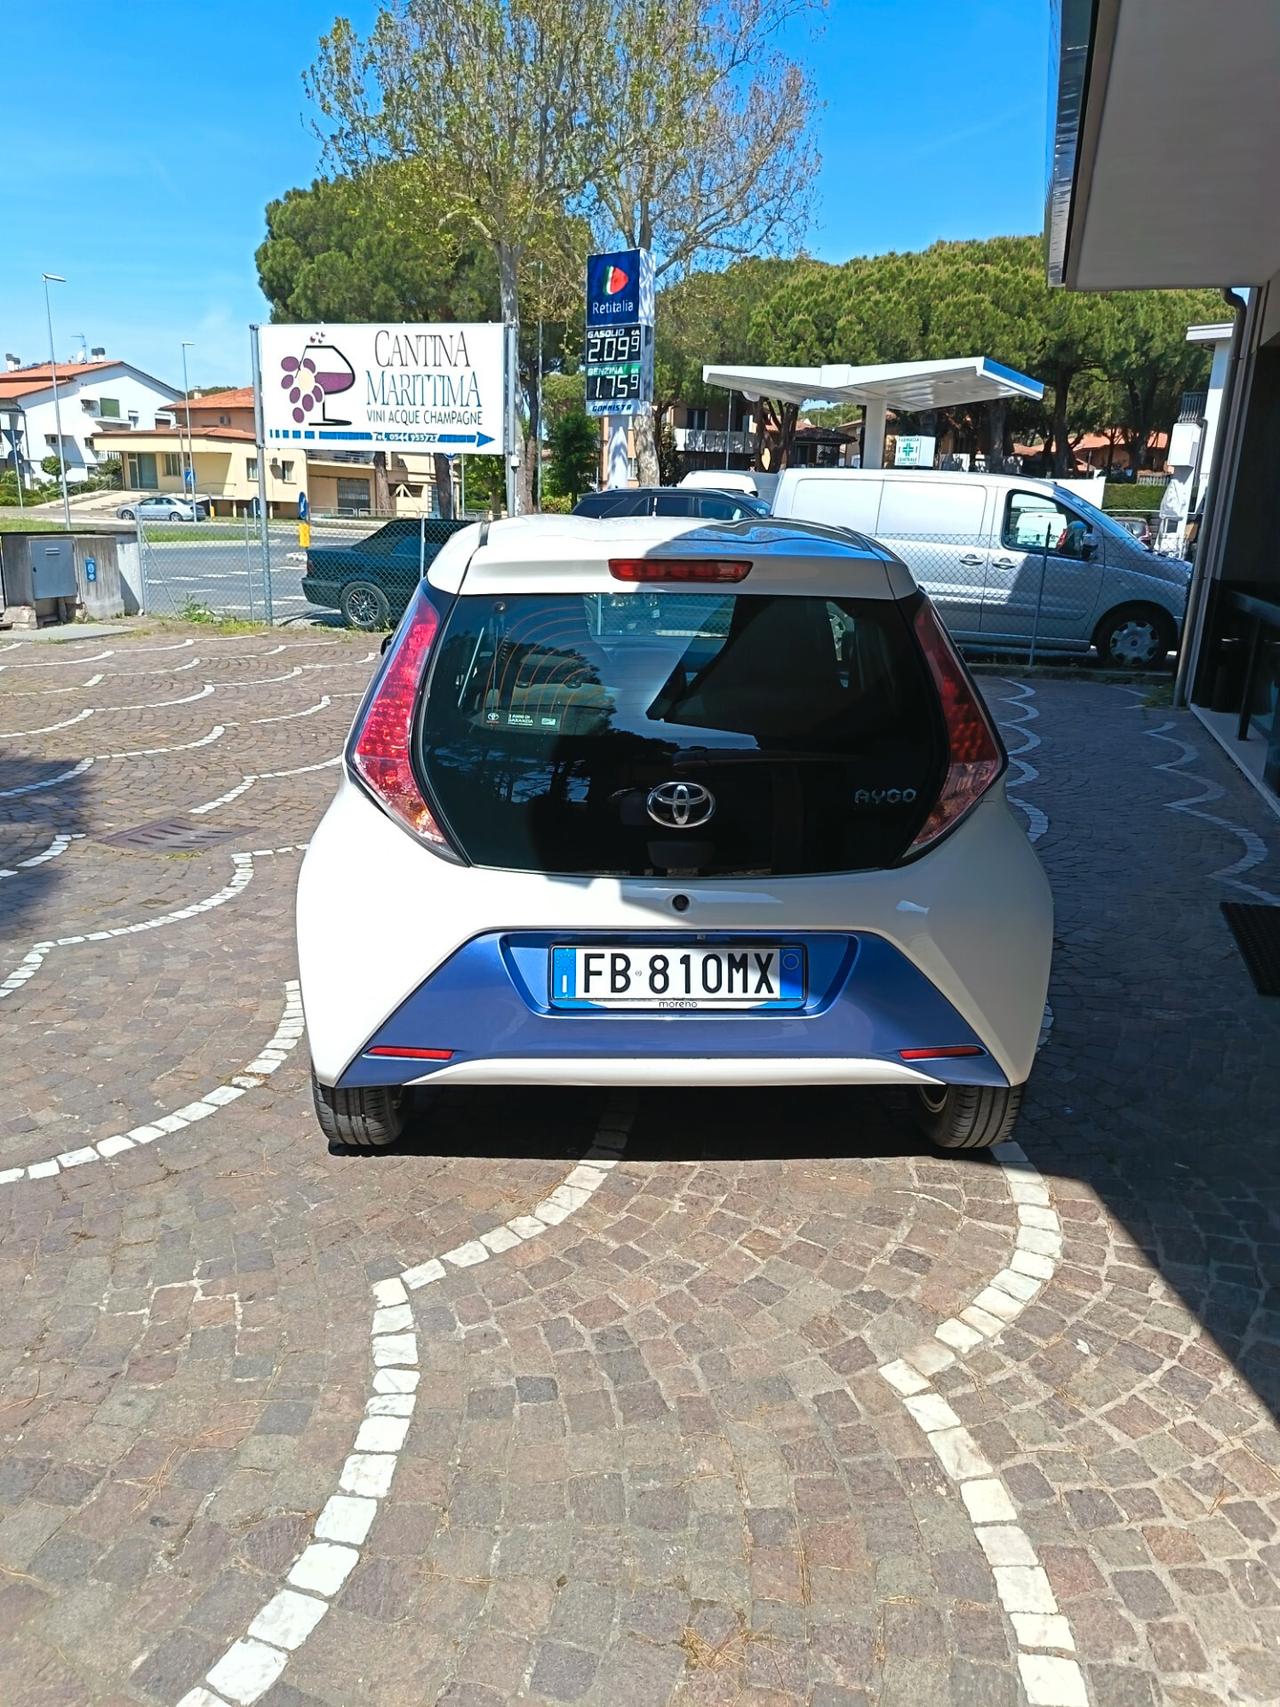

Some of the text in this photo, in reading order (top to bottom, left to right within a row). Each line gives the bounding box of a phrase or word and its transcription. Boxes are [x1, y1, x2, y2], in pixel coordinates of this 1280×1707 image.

[592, 300, 634, 314] Retitalia
[587, 329, 625, 339] GASOLIO
[374, 329, 471, 368] CANTINA
[587, 366, 624, 376] BENZINA
[365, 370, 482, 408] MARITTIMA
[592, 404, 632, 412] GOMMISTA
[366, 409, 483, 426] VINI ACQUE CHAMPAGNE
[855, 788, 917, 804] AYGO
[584, 953, 631, 994] FB
[649, 953, 775, 994] 810MX
[658, 1000, 698, 1009] moreno
